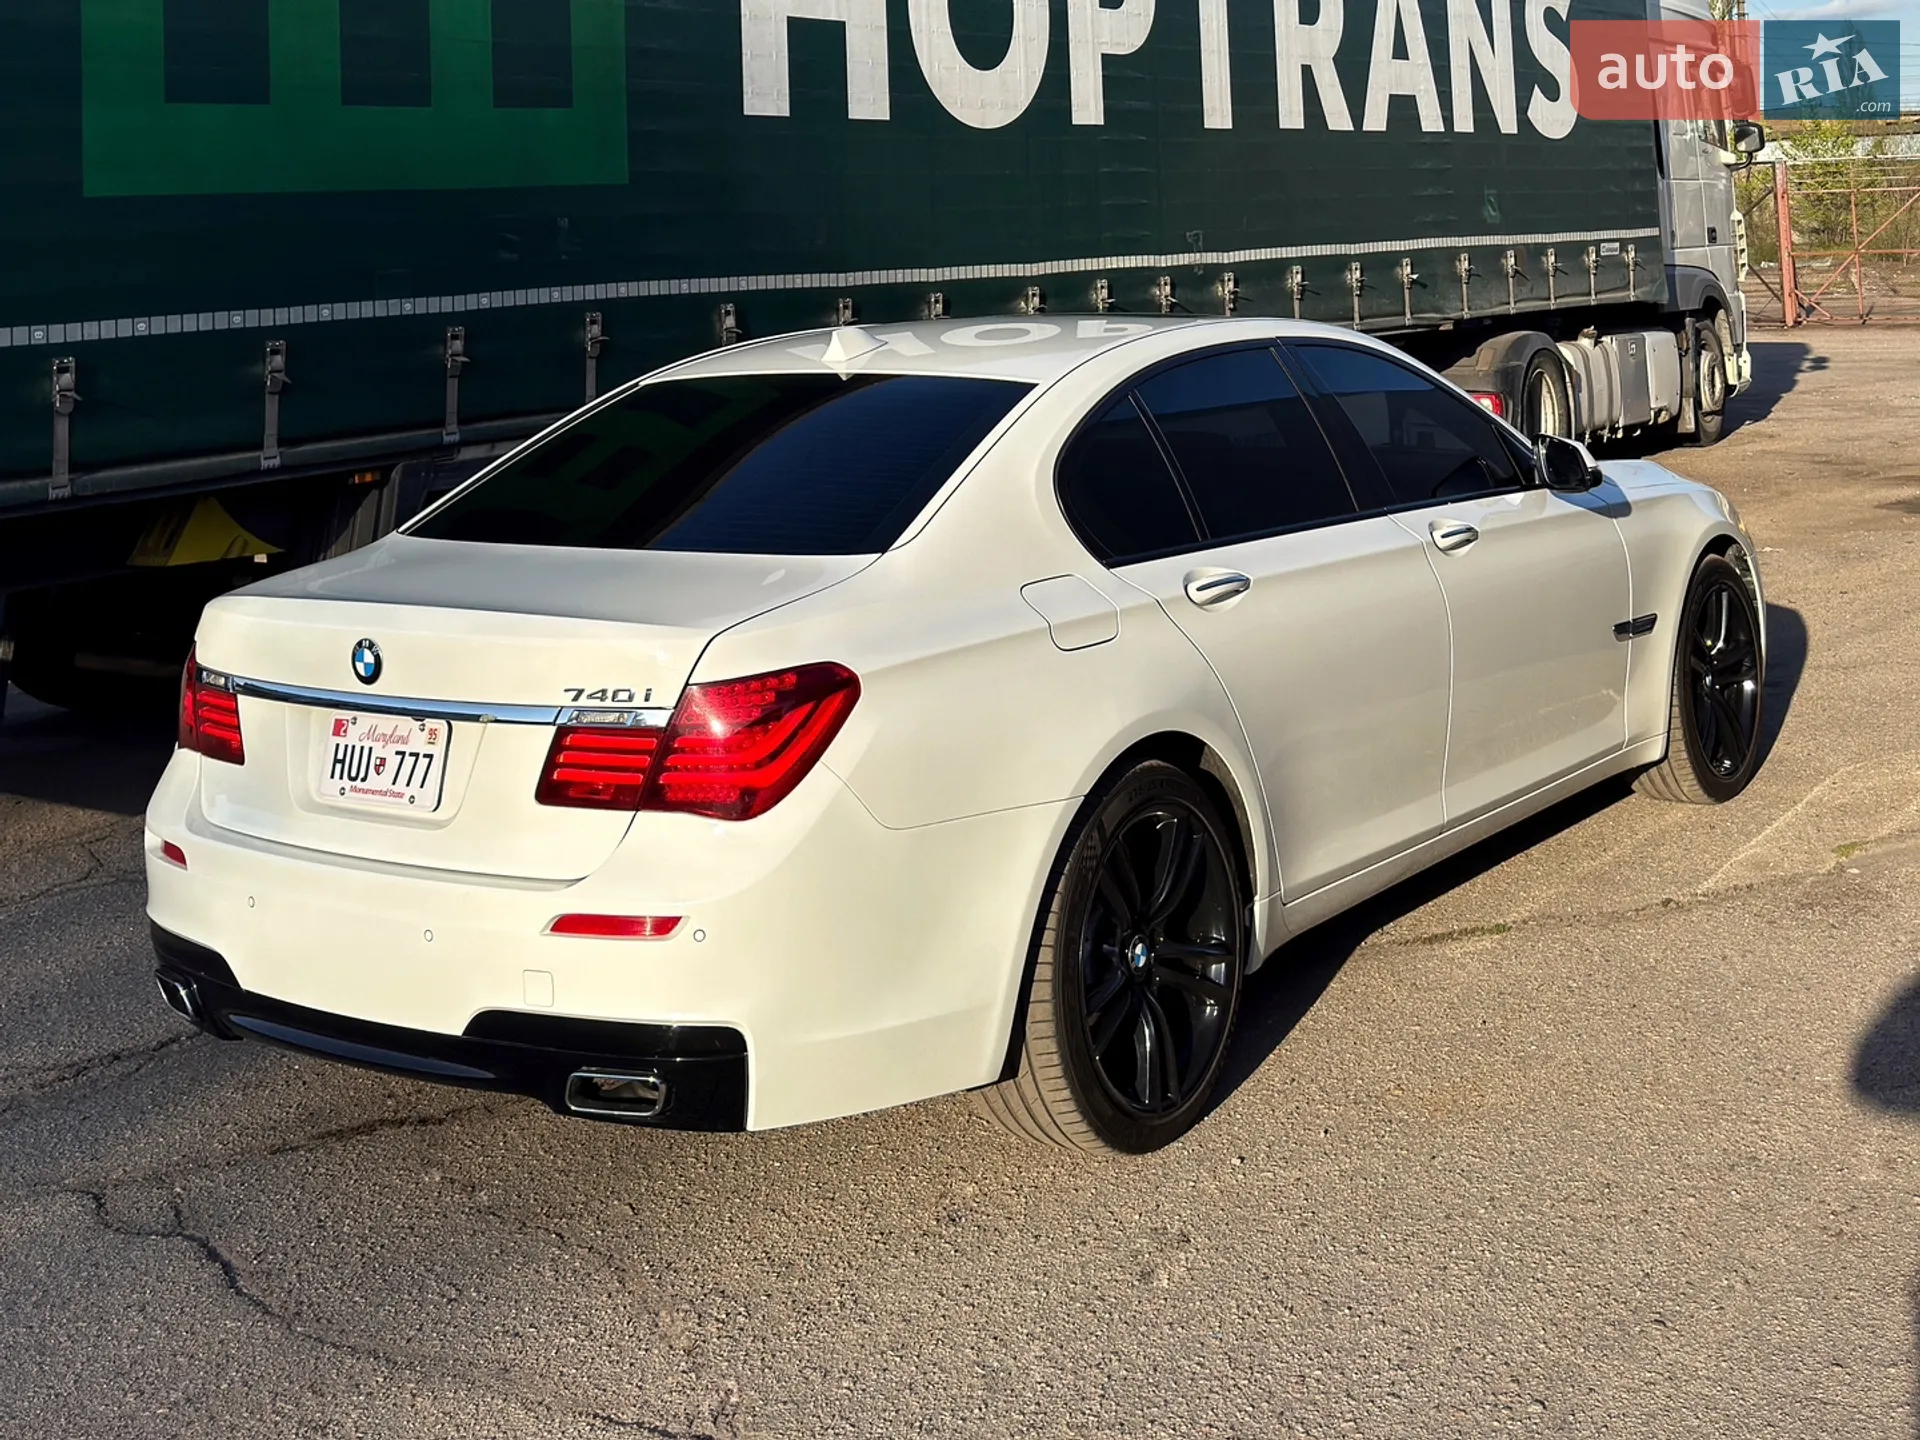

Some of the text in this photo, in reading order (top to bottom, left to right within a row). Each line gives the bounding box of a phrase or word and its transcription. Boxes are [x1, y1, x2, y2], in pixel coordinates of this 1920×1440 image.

[358, 723, 413, 749] Maryland
[427, 727, 438, 741] 95
[330, 743, 434, 788] HUJ 777
